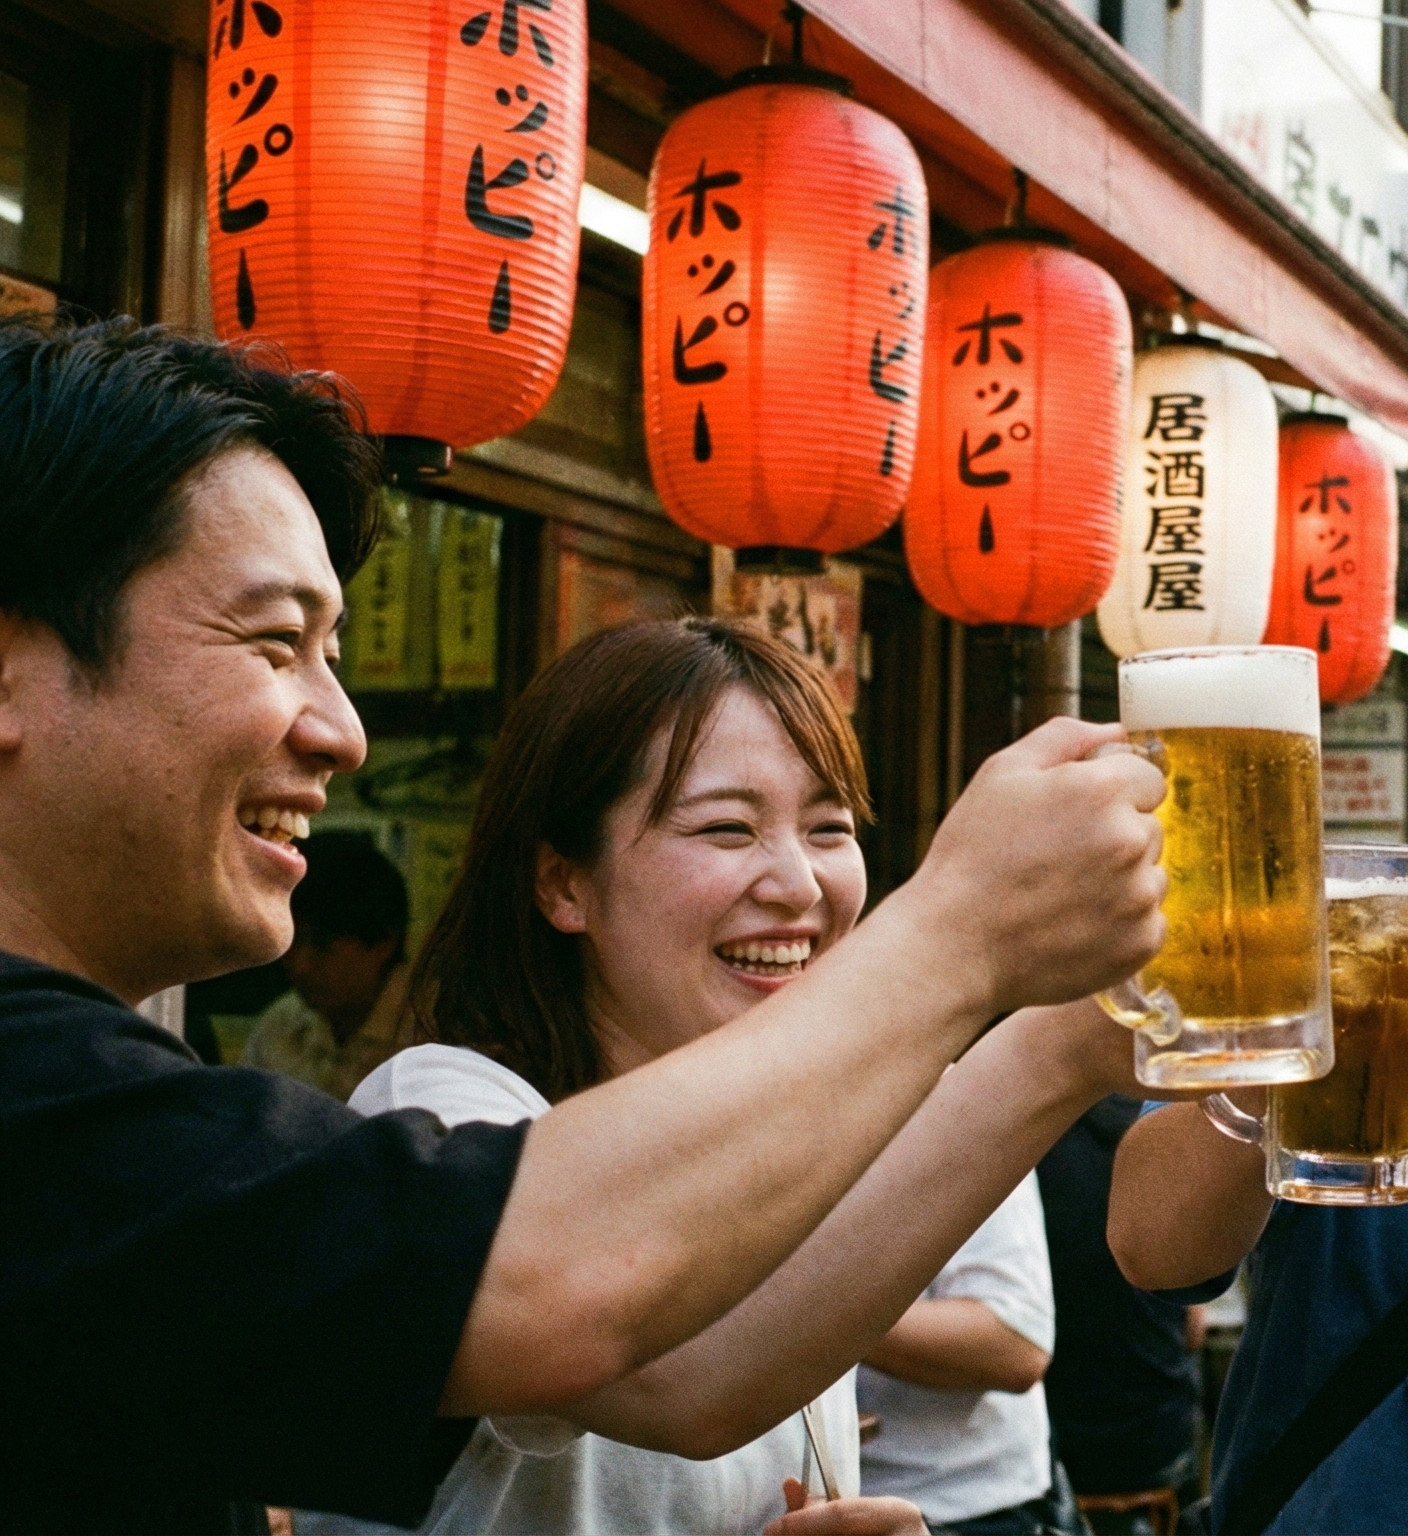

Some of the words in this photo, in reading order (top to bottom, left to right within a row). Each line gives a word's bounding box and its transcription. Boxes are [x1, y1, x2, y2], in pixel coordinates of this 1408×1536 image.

[666, 157, 750, 464] ホッピー
[952, 302, 1031, 555] ホッピー
[1143, 392, 1209, 613] 居酒屋屋
[1298, 470, 1357, 654] ホッピー
